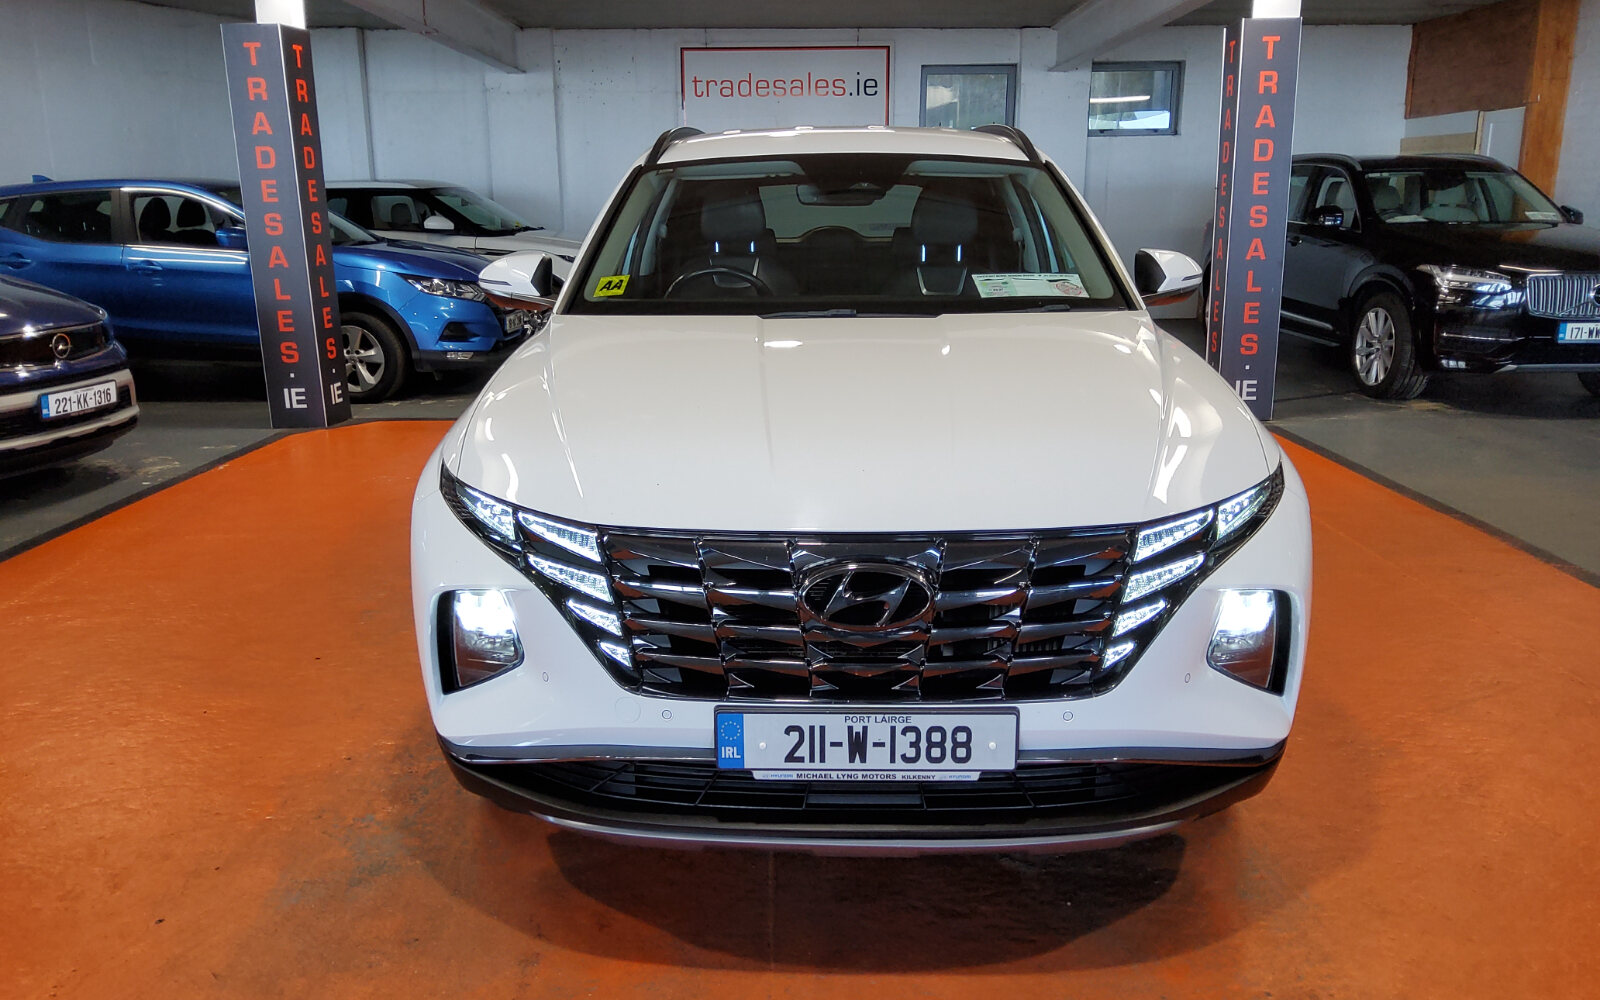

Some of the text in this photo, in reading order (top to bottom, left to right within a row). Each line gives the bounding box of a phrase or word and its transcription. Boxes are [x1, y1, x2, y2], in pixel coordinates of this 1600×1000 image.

[692, 71, 878, 98] tradesales.ie
[599, 279, 625, 292] AA
[54, 387, 112, 414] 221-KK-1316
[844, 713, 912, 724] PORT LÁIRGE
[721, 746, 741, 759] IRL
[784, 725, 973, 764] 211-W-1388
